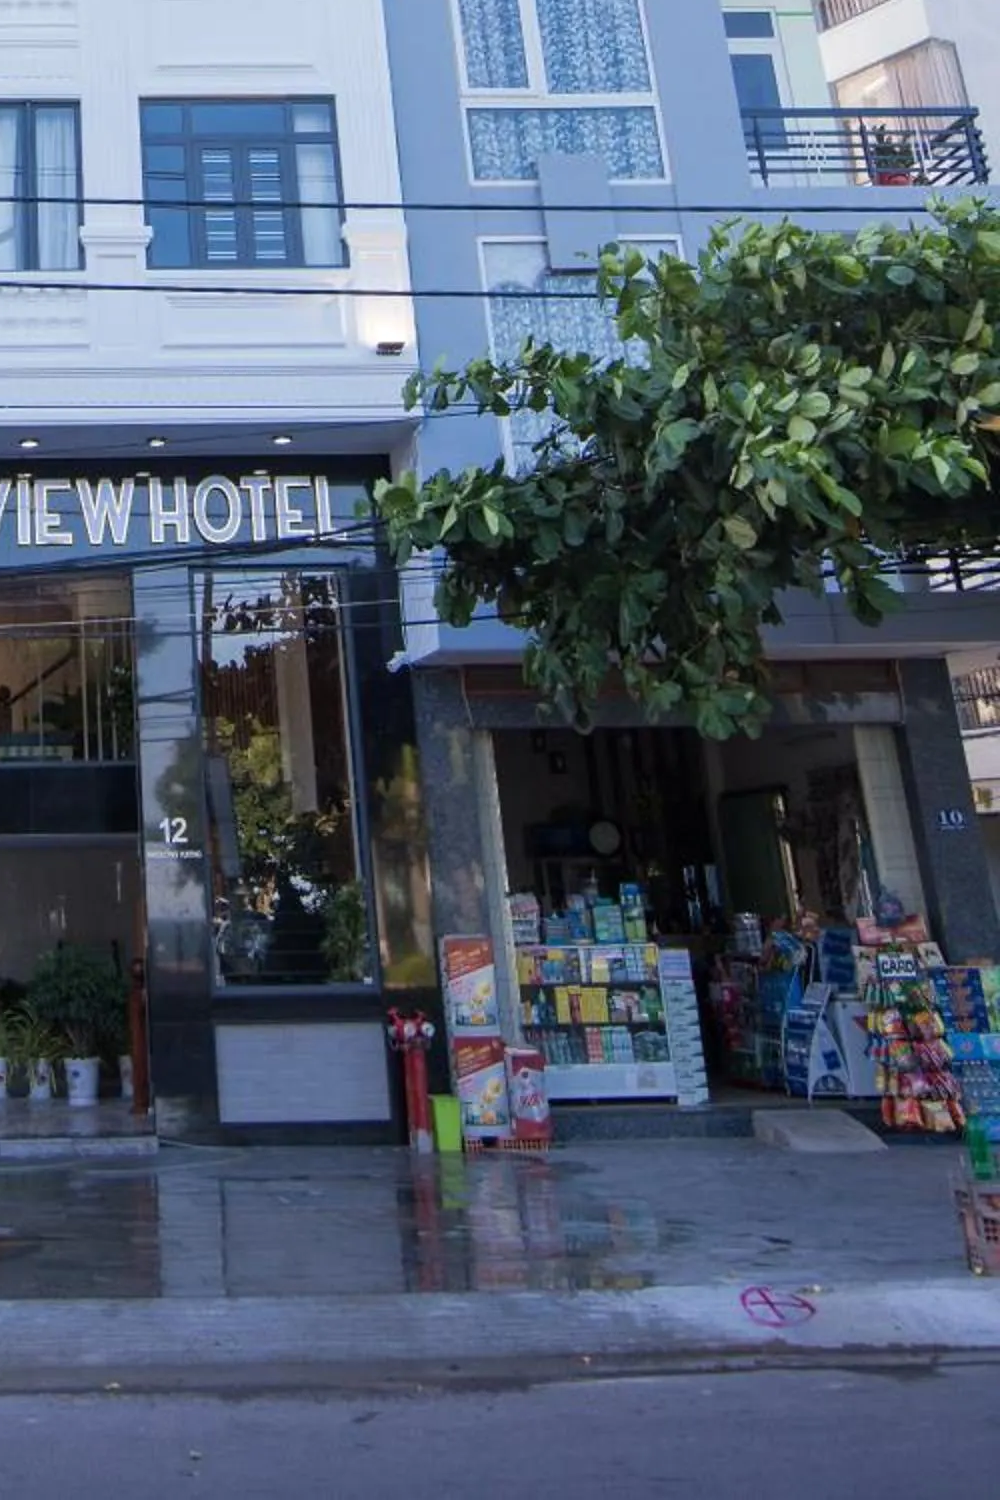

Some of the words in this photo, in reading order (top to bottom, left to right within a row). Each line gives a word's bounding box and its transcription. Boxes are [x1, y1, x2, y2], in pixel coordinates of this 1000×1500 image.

[147, 475, 348, 545] HOTEL
[159, 817, 189, 844] 12
[940, 809, 964, 825] 10
